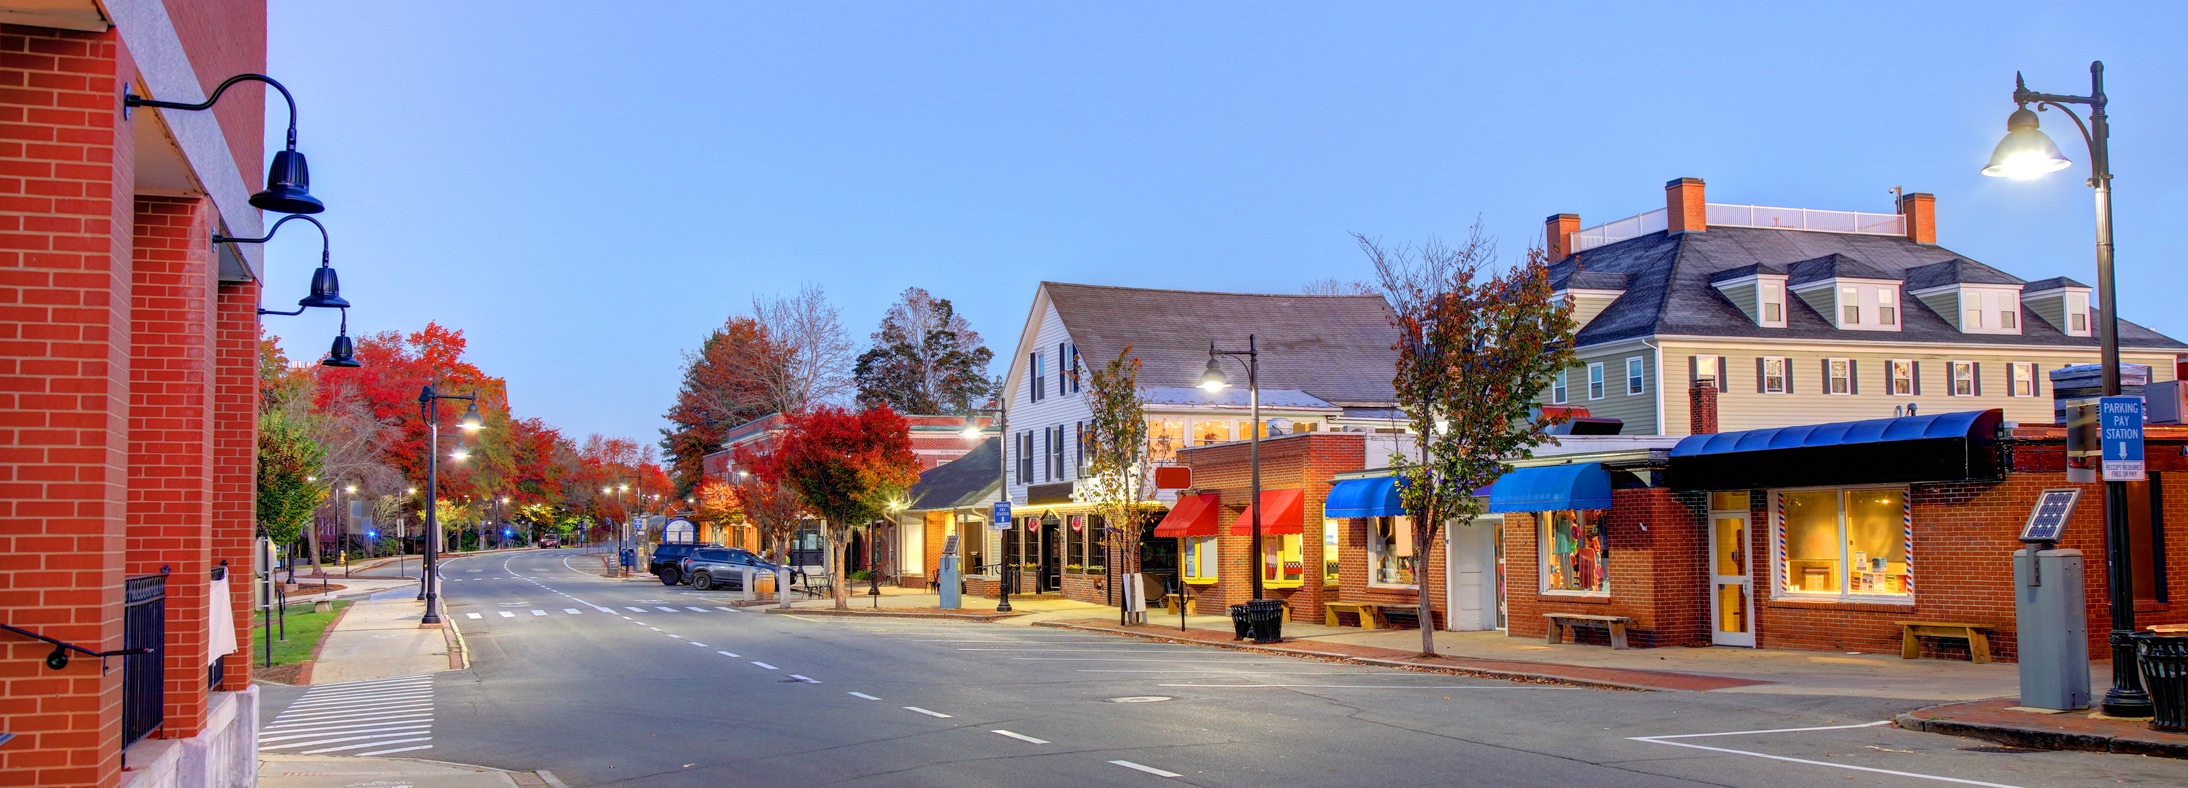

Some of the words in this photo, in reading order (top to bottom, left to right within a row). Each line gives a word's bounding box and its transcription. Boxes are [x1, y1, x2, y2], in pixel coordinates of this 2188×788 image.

[2104, 402, 2138, 413] PARKING
[2114, 415, 2130, 426] PAY
[2106, 428, 2138, 439] STATION
